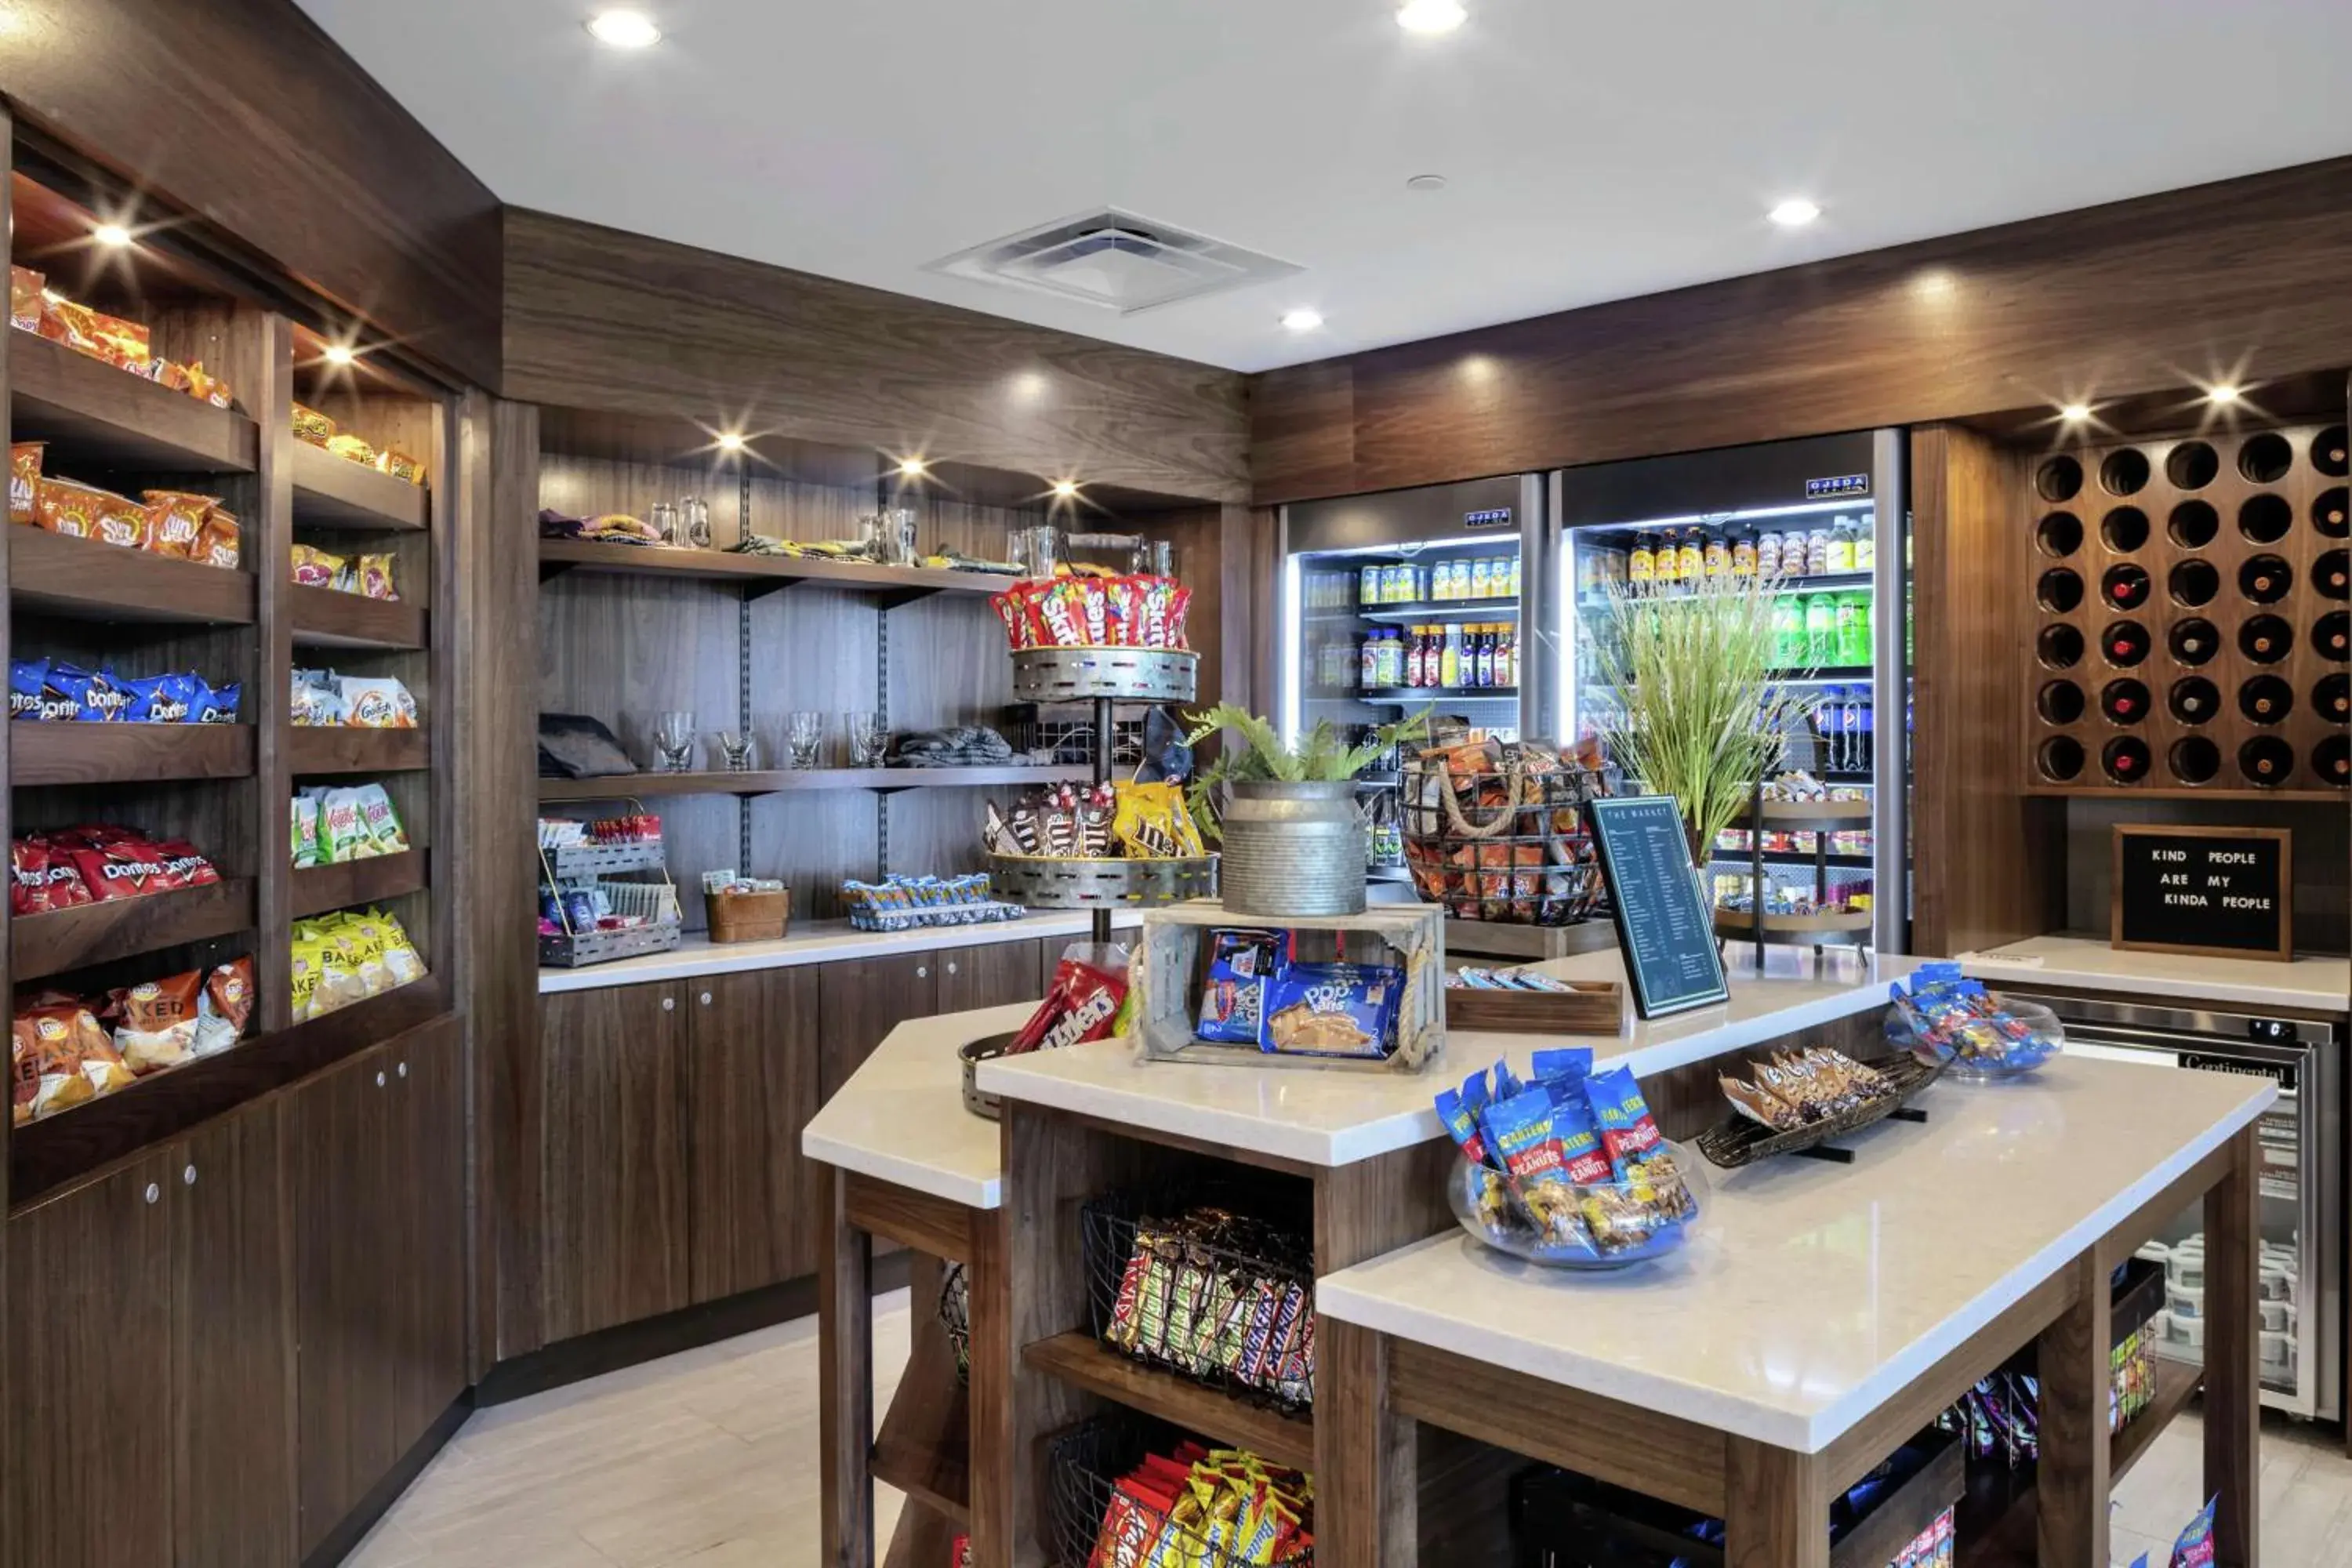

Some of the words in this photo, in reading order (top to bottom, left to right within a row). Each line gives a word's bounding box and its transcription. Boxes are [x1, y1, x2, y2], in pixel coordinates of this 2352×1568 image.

[2152, 850, 2187, 862] KIND
[2209, 851, 2256, 864] PEOPLE
[103, 862, 161, 879] Doritos
[2161, 873, 2188, 884] ARE
[2208, 876, 2230, 887] MY
[2165, 894, 2208, 906] KINDA
[2223, 896, 2270, 909] PEOPLE
